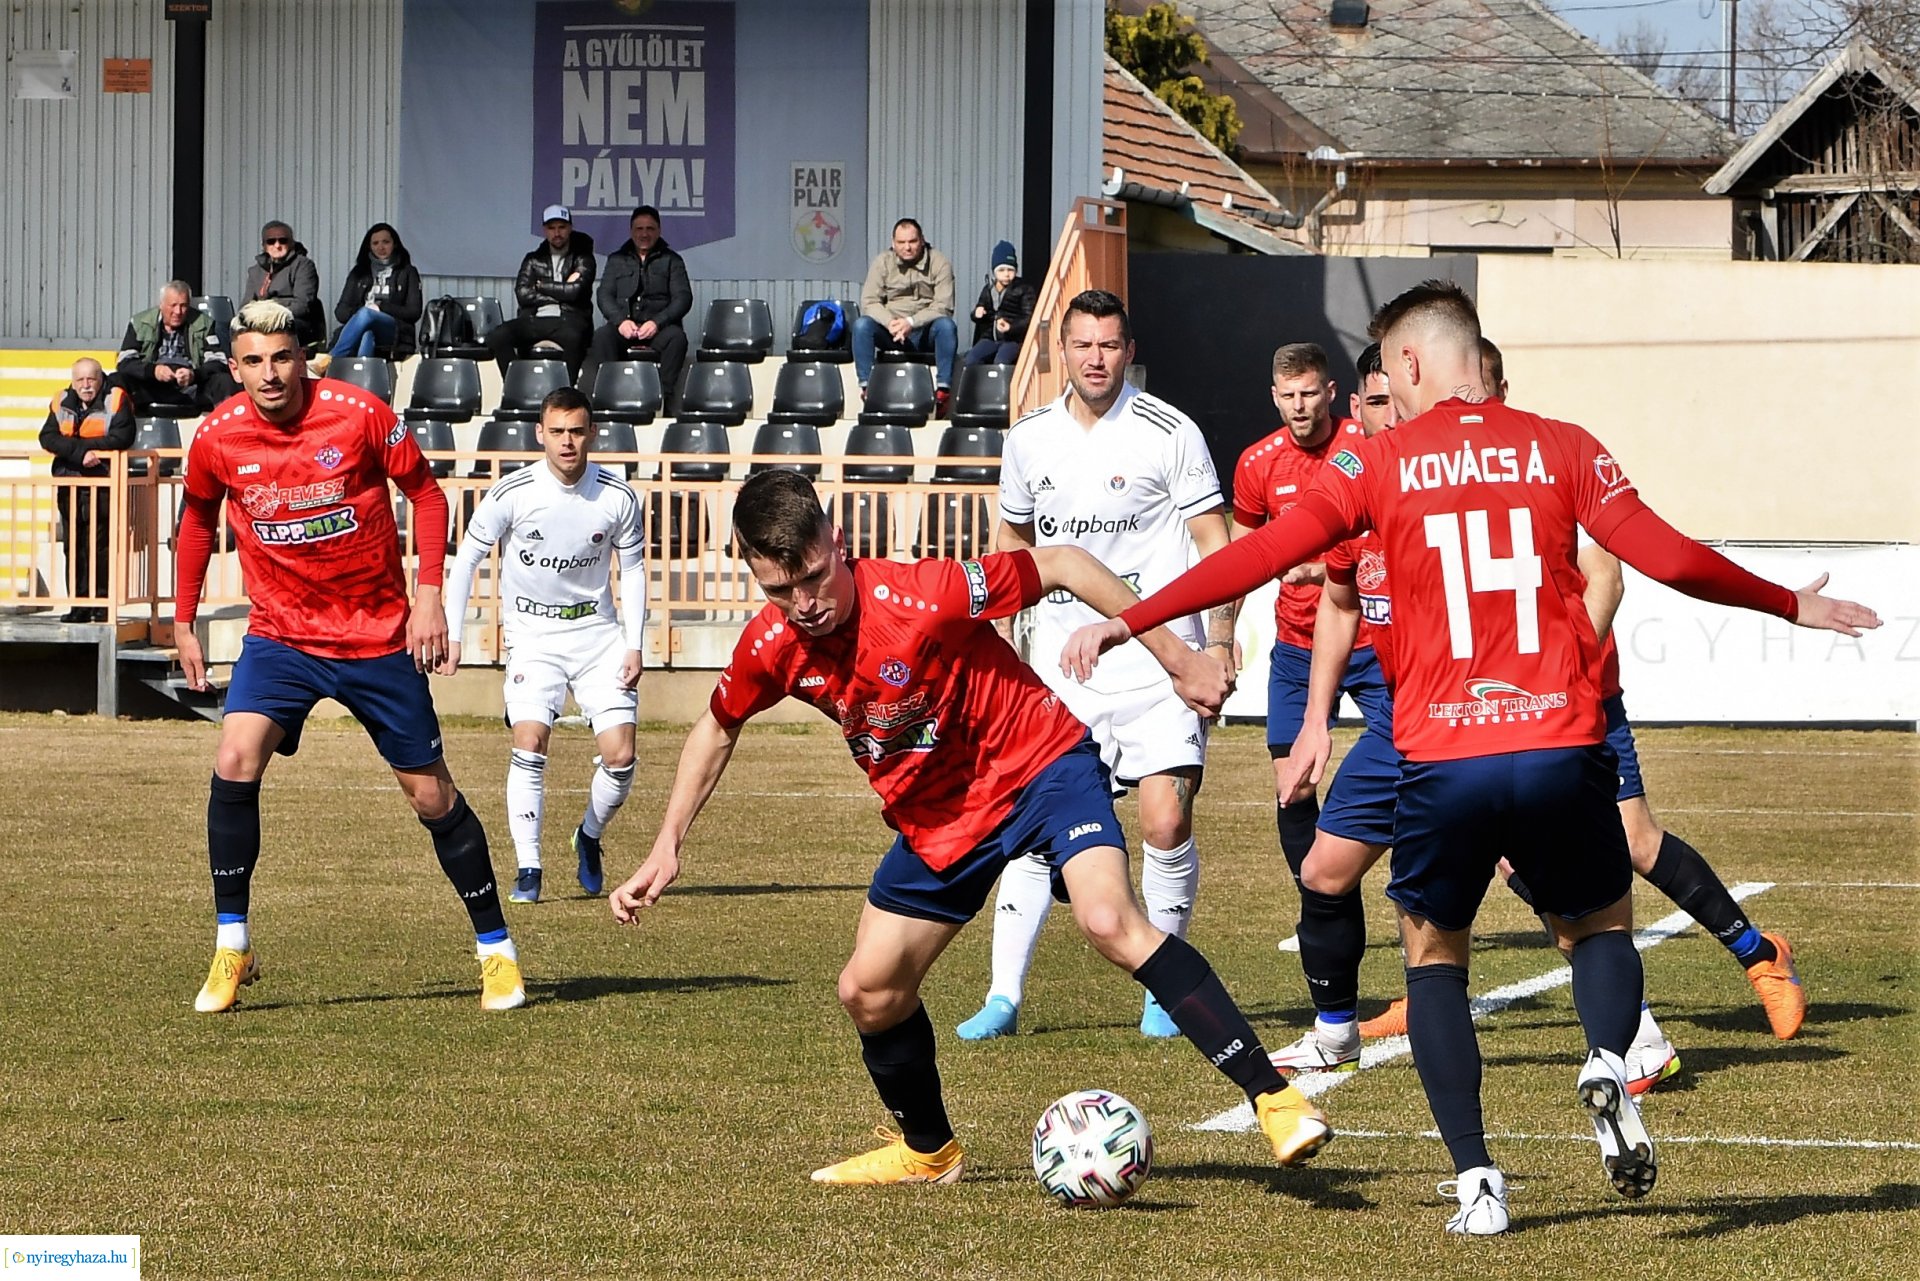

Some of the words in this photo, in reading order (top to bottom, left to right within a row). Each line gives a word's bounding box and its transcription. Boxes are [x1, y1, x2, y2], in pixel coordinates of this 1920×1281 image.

[563, 40, 580, 67] A
[586, 33, 705, 68] GYŰLÖLET
[563, 70, 705, 146] NEM
[562, 149, 705, 208] PÁLYA!
[794, 168, 842, 187] FAIR
[793, 188, 840, 207] PLAY
[237, 463, 261, 475] JAKO
[1400, 440, 1519, 493] KOVÁCS
[1062, 513, 1141, 539] otpbank
[1423, 506, 1543, 661] 14
[799, 675, 826, 687] JAKO
[1502, 692, 1568, 713] TRANS
[1068, 822, 1103, 841] JAKO
[213, 866, 245, 876] JAKO
[463, 882, 492, 898] JAKO
[1211, 1038, 1244, 1067] JAKO
